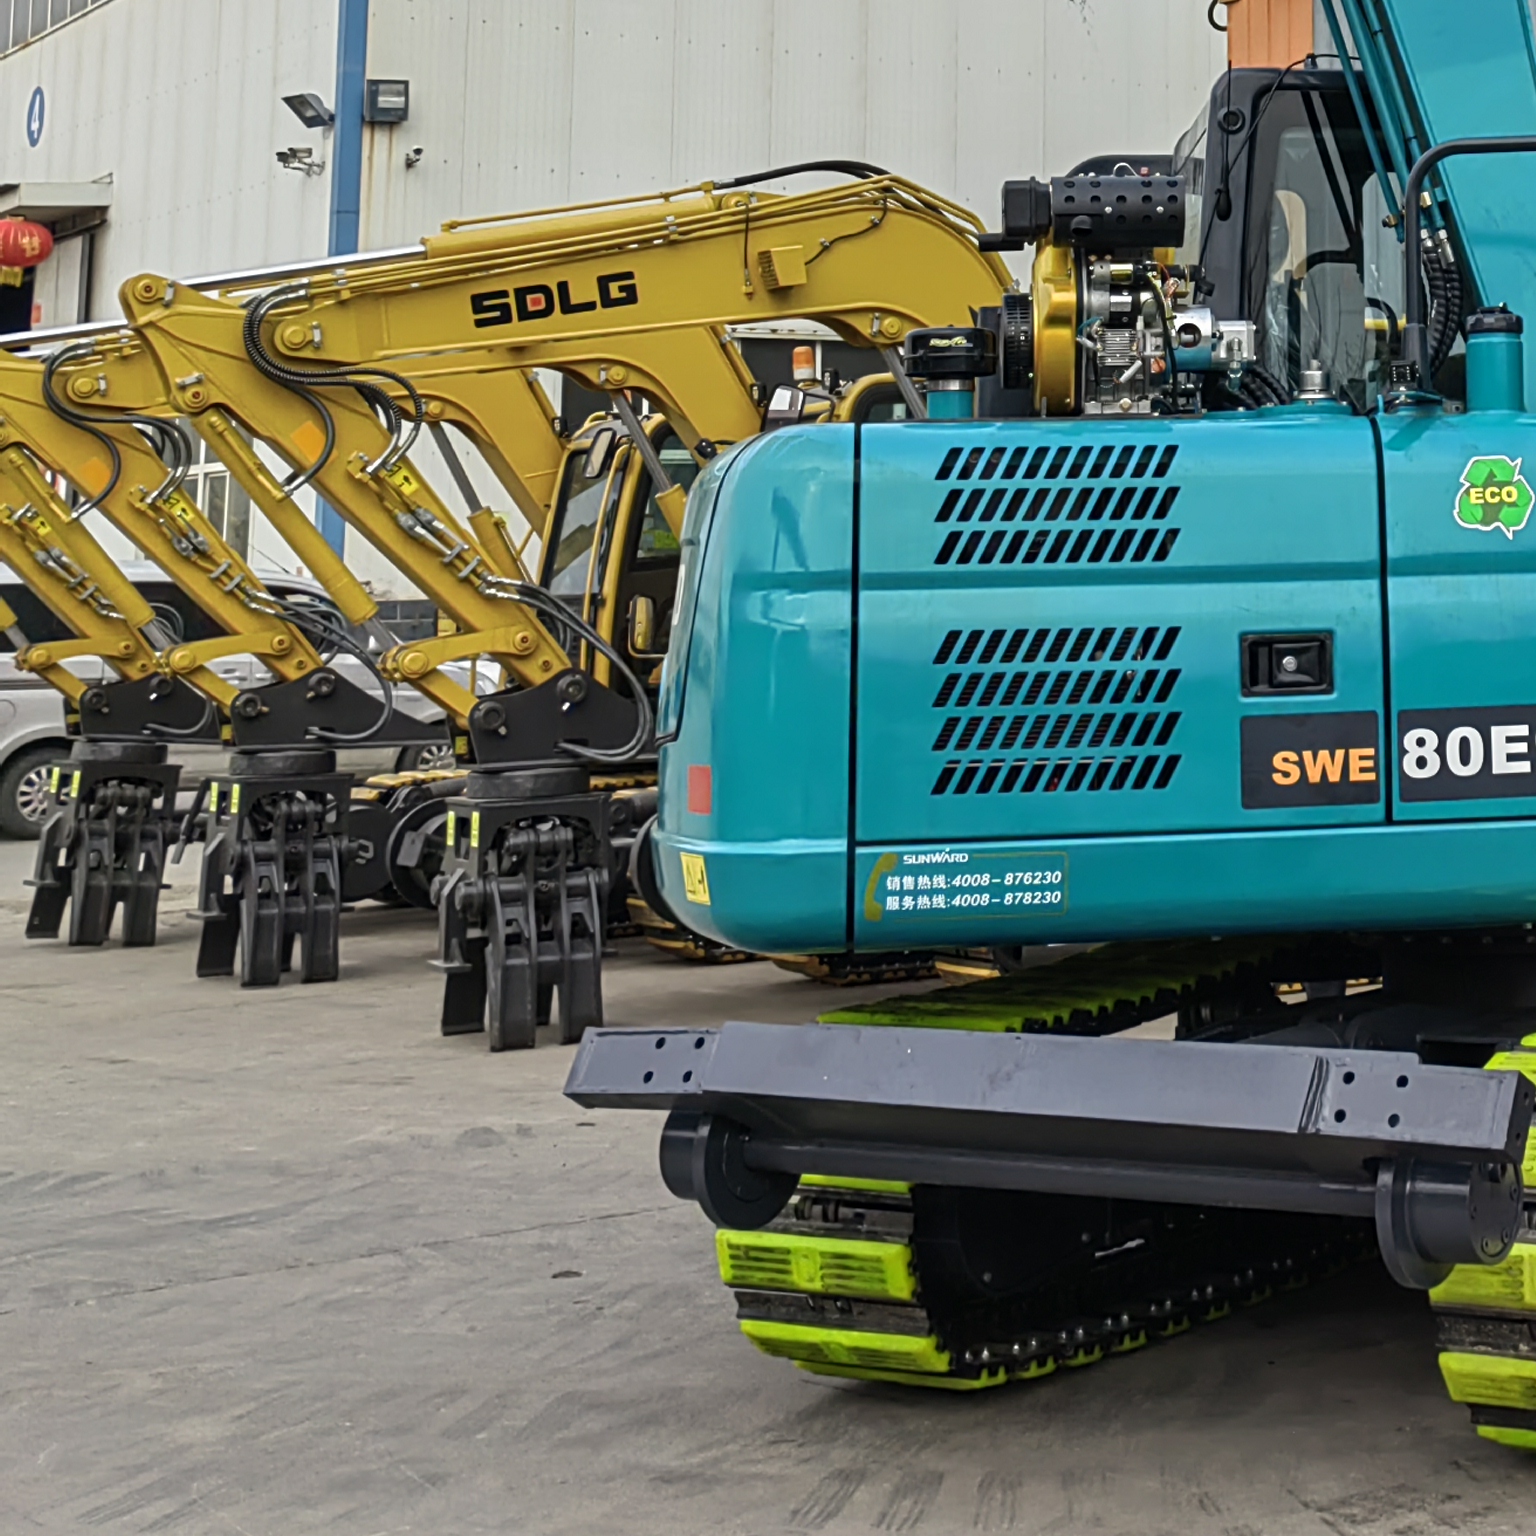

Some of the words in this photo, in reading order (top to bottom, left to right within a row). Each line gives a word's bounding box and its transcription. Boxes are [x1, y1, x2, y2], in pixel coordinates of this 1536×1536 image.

[30, 93, 41, 139] 4
[470, 271, 638, 328] SDLG
[1469, 485, 1518, 504] ECO
[1271, 747, 1377, 786] SWE
[903, 847, 969, 864] SUNWARD
